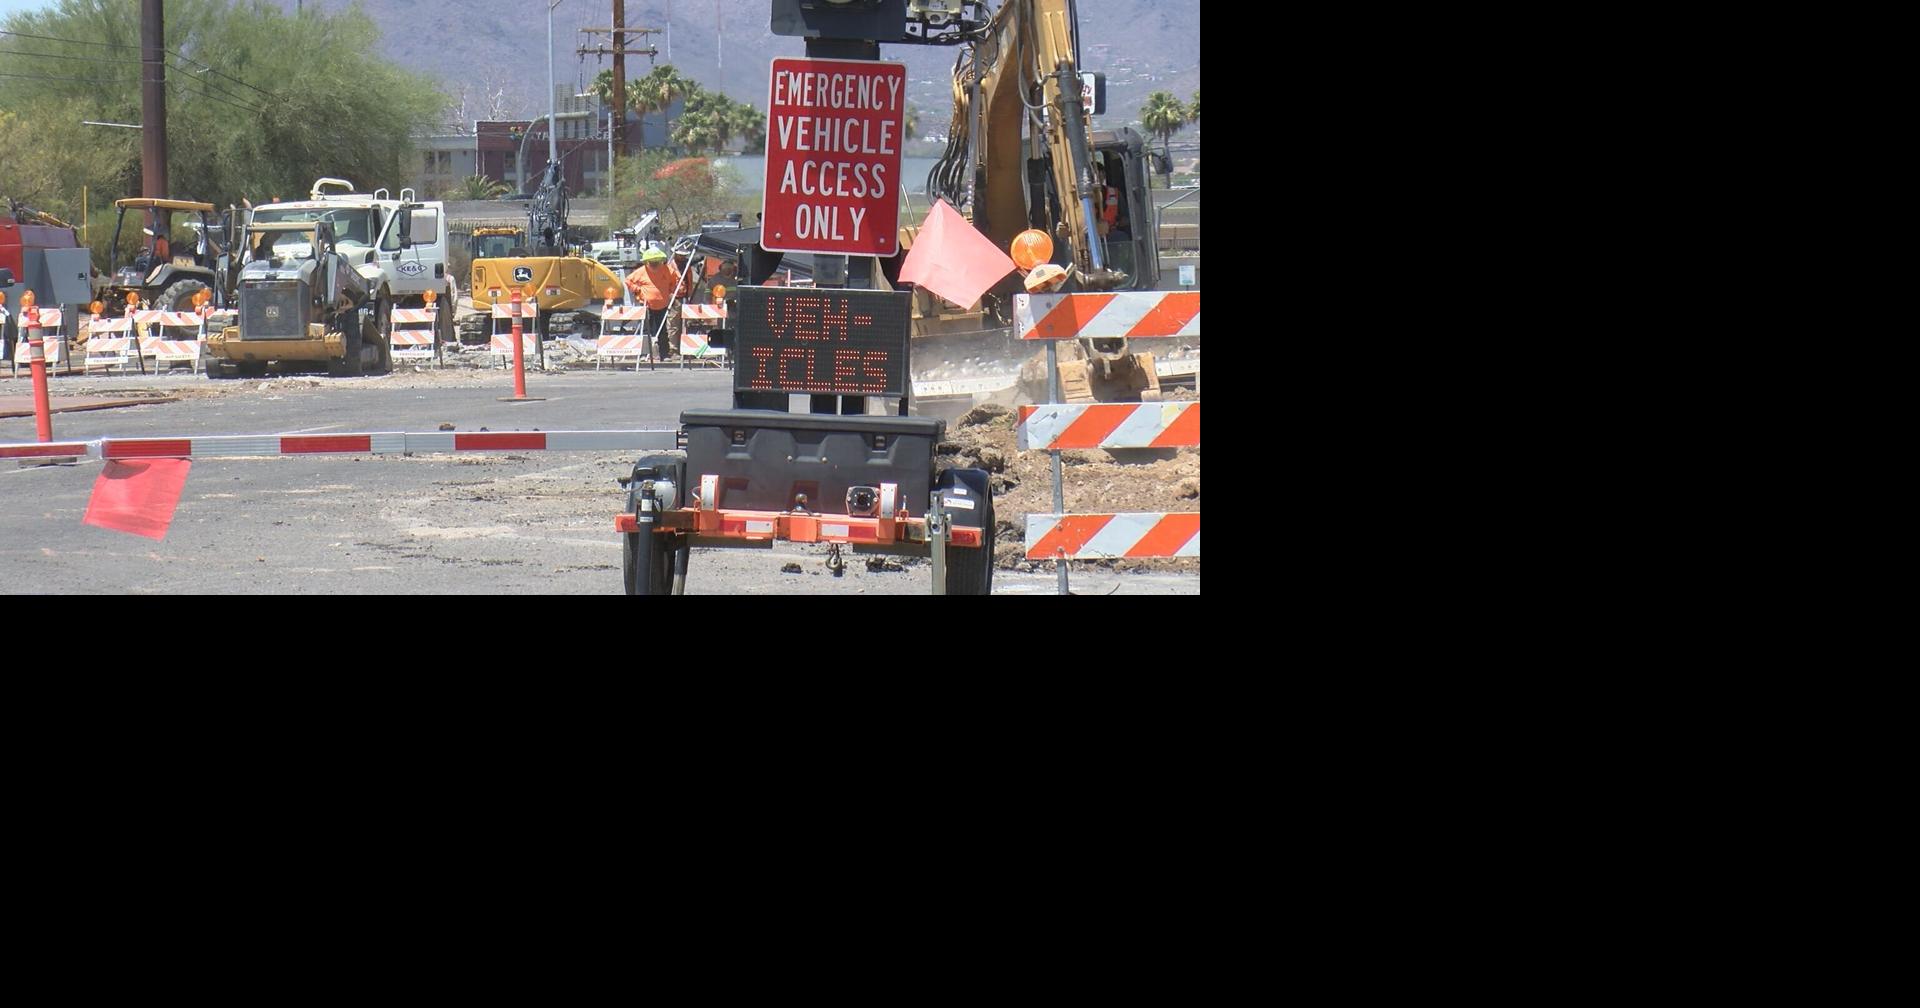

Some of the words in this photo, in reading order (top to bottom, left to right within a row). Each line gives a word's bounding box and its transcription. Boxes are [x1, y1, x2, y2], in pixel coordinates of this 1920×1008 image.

[774, 71, 901, 111] EMERGENCY
[777, 115, 896, 155] VEHICLE
[780, 159, 886, 199] ACCESS
[795, 203, 867, 241] ONLY
[767, 296, 872, 341] VEH-
[751, 347, 888, 393] ICLES
